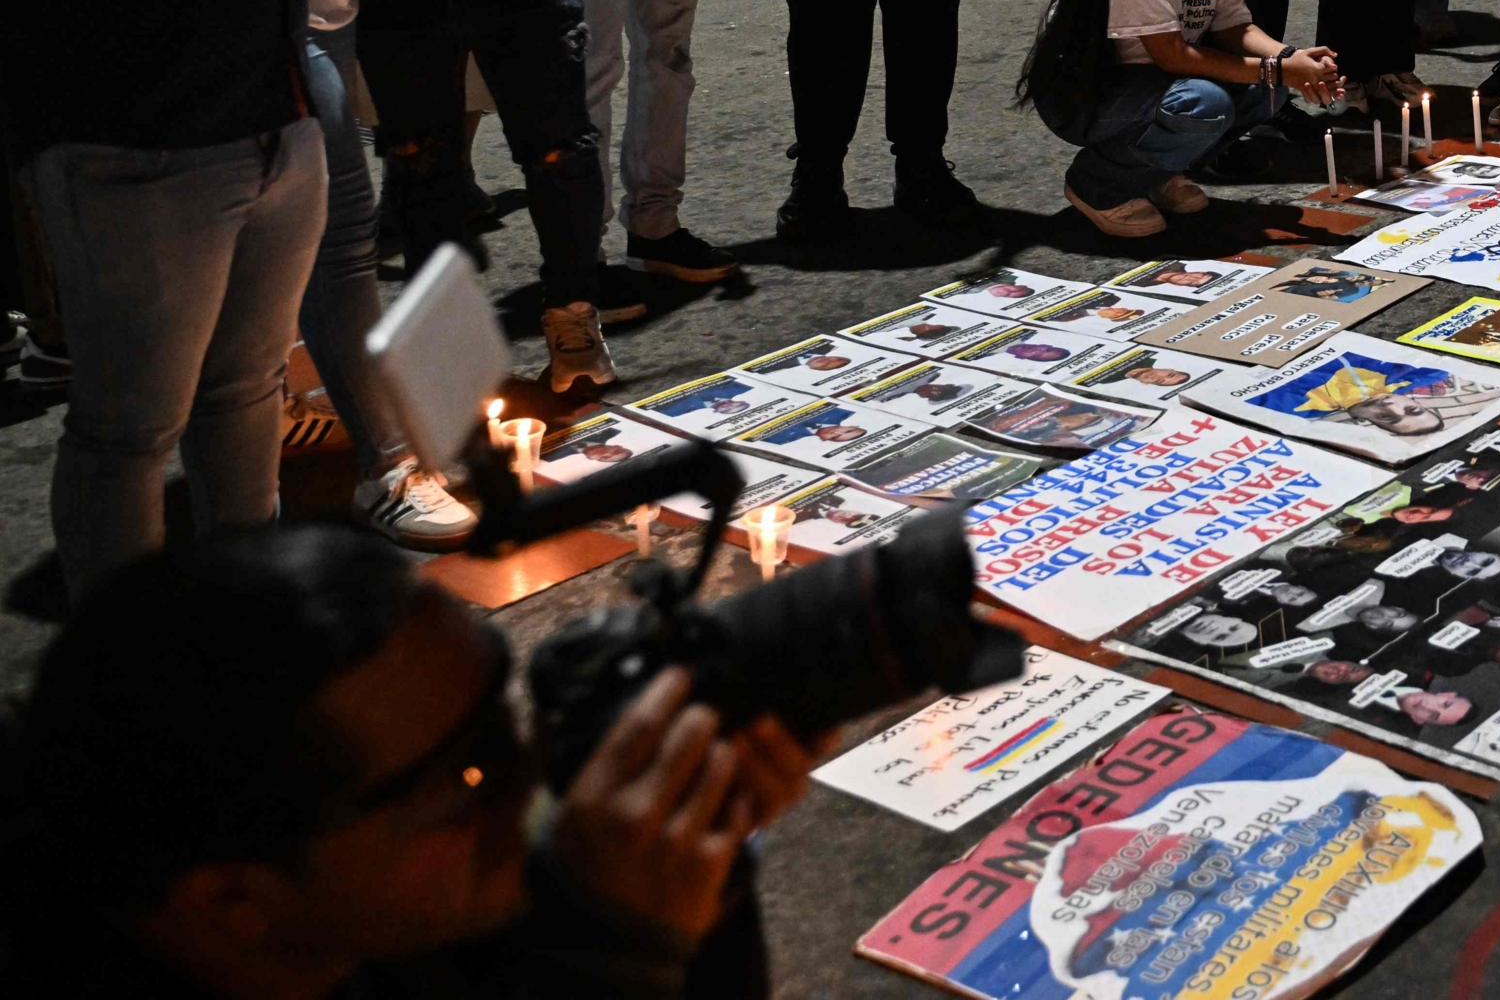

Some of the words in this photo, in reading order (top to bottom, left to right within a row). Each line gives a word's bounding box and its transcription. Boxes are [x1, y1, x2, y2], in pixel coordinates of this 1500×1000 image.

[1161, 313, 1229, 344] Manzano
[1274, 320, 1340, 351] Libertad
[1280, 313, 1321, 330] para
[1273, 347, 1335, 376] ALBERTO
[1229, 375, 1284, 397] BRACHO
[939, 461, 1003, 492] PRESOS
[1139, 435, 1268, 493] ZULIA
[970, 446, 1197, 558] POLITICOS
[1098, 437, 1293, 540] ALCALDES
[1182, 464, 1302, 515] PARA
[1113, 472, 1322, 576] AMNISTIA
[1243, 497, 1333, 542] LEY
[992, 545, 1093, 590] DEL
[1081, 527, 1173, 575] LOS
[1160, 547, 1233, 583] DE
[1113, 689, 1149, 706] No
[1031, 710, 1111, 761] estamos
[1051, 788, 1227, 924] Venezolanas
[1111, 815, 1226, 912] carceles
[1188, 795, 1301, 888] matando
[1216, 869, 1260, 908] los
[1149, 893, 1193, 934] en
[1108, 931, 1150, 970] las
